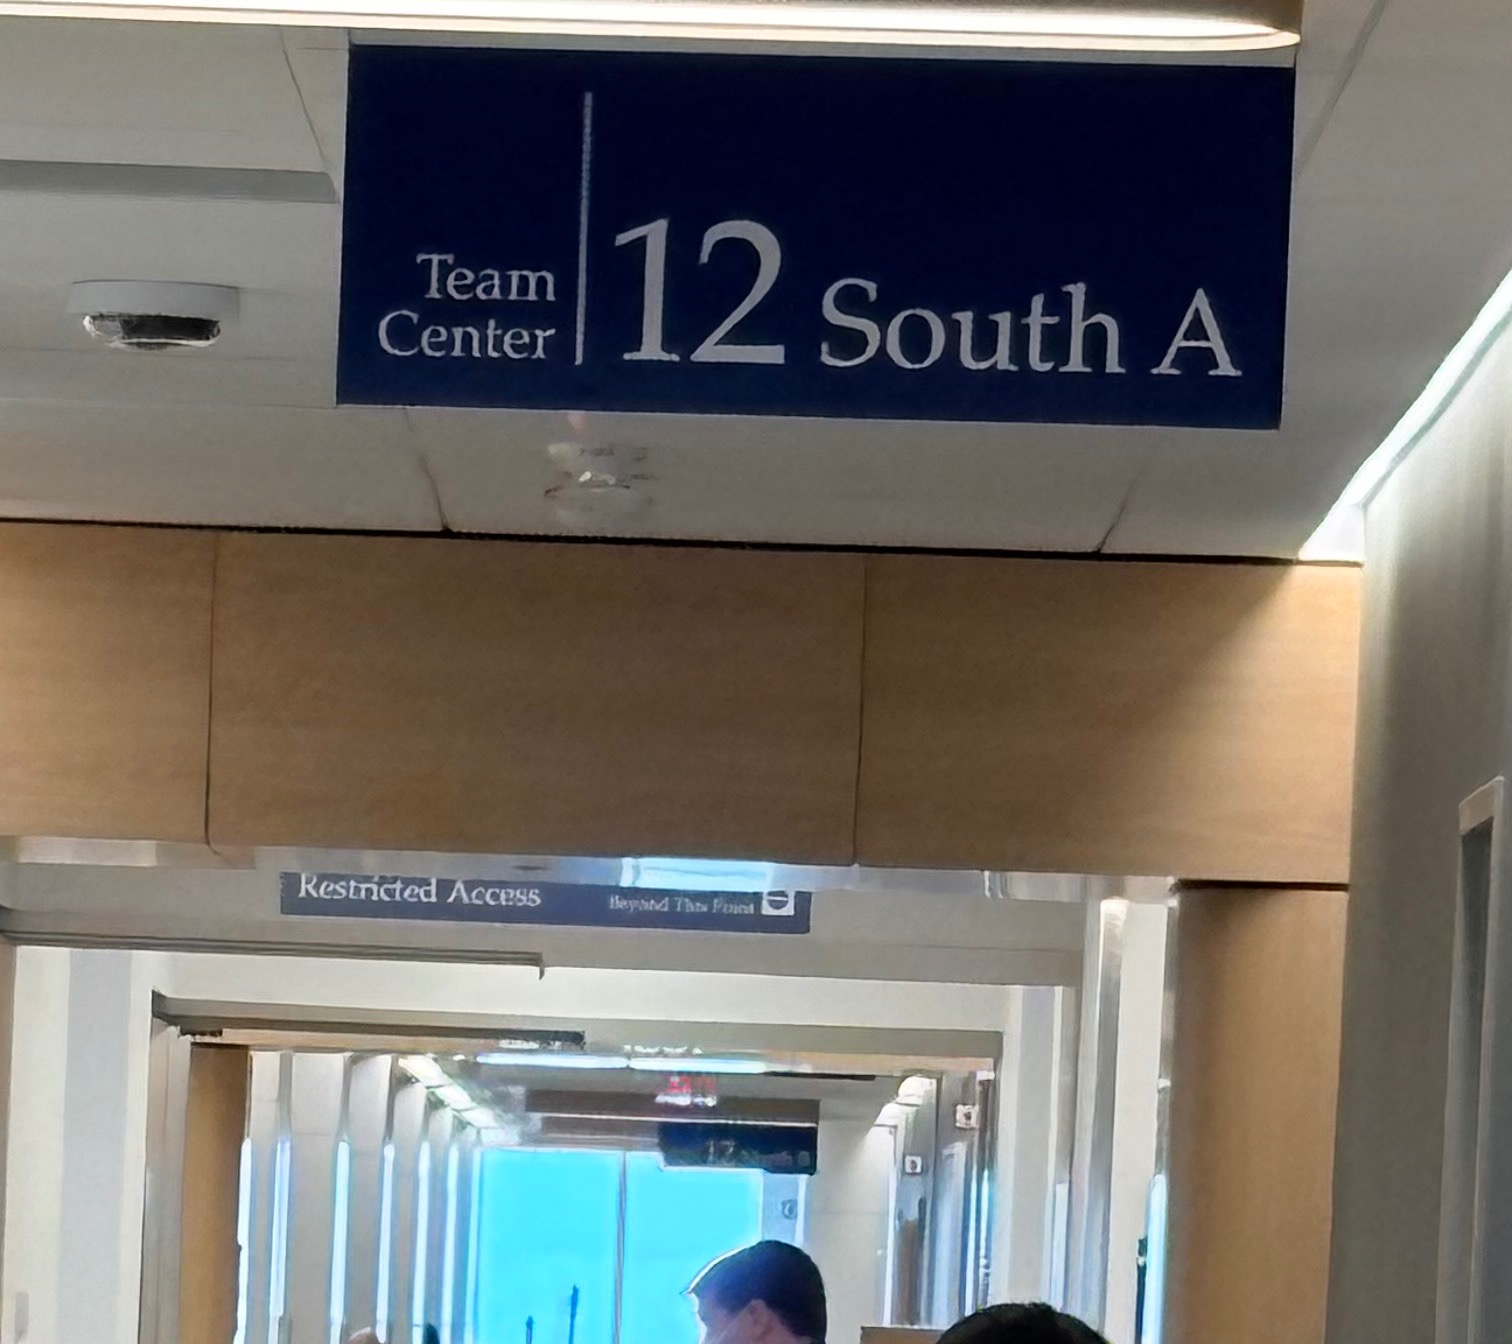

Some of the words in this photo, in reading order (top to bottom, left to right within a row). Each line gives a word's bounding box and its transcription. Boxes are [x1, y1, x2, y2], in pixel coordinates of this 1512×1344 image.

[417, 253, 555, 301] Team
[615, 218, 785, 365] 12
[820, 278, 1126, 373] South
[1150, 288, 1242, 377] A
[378, 309, 556, 359] Center
[298, 872, 438, 903] Restricted
[447, 880, 542, 907] Access
